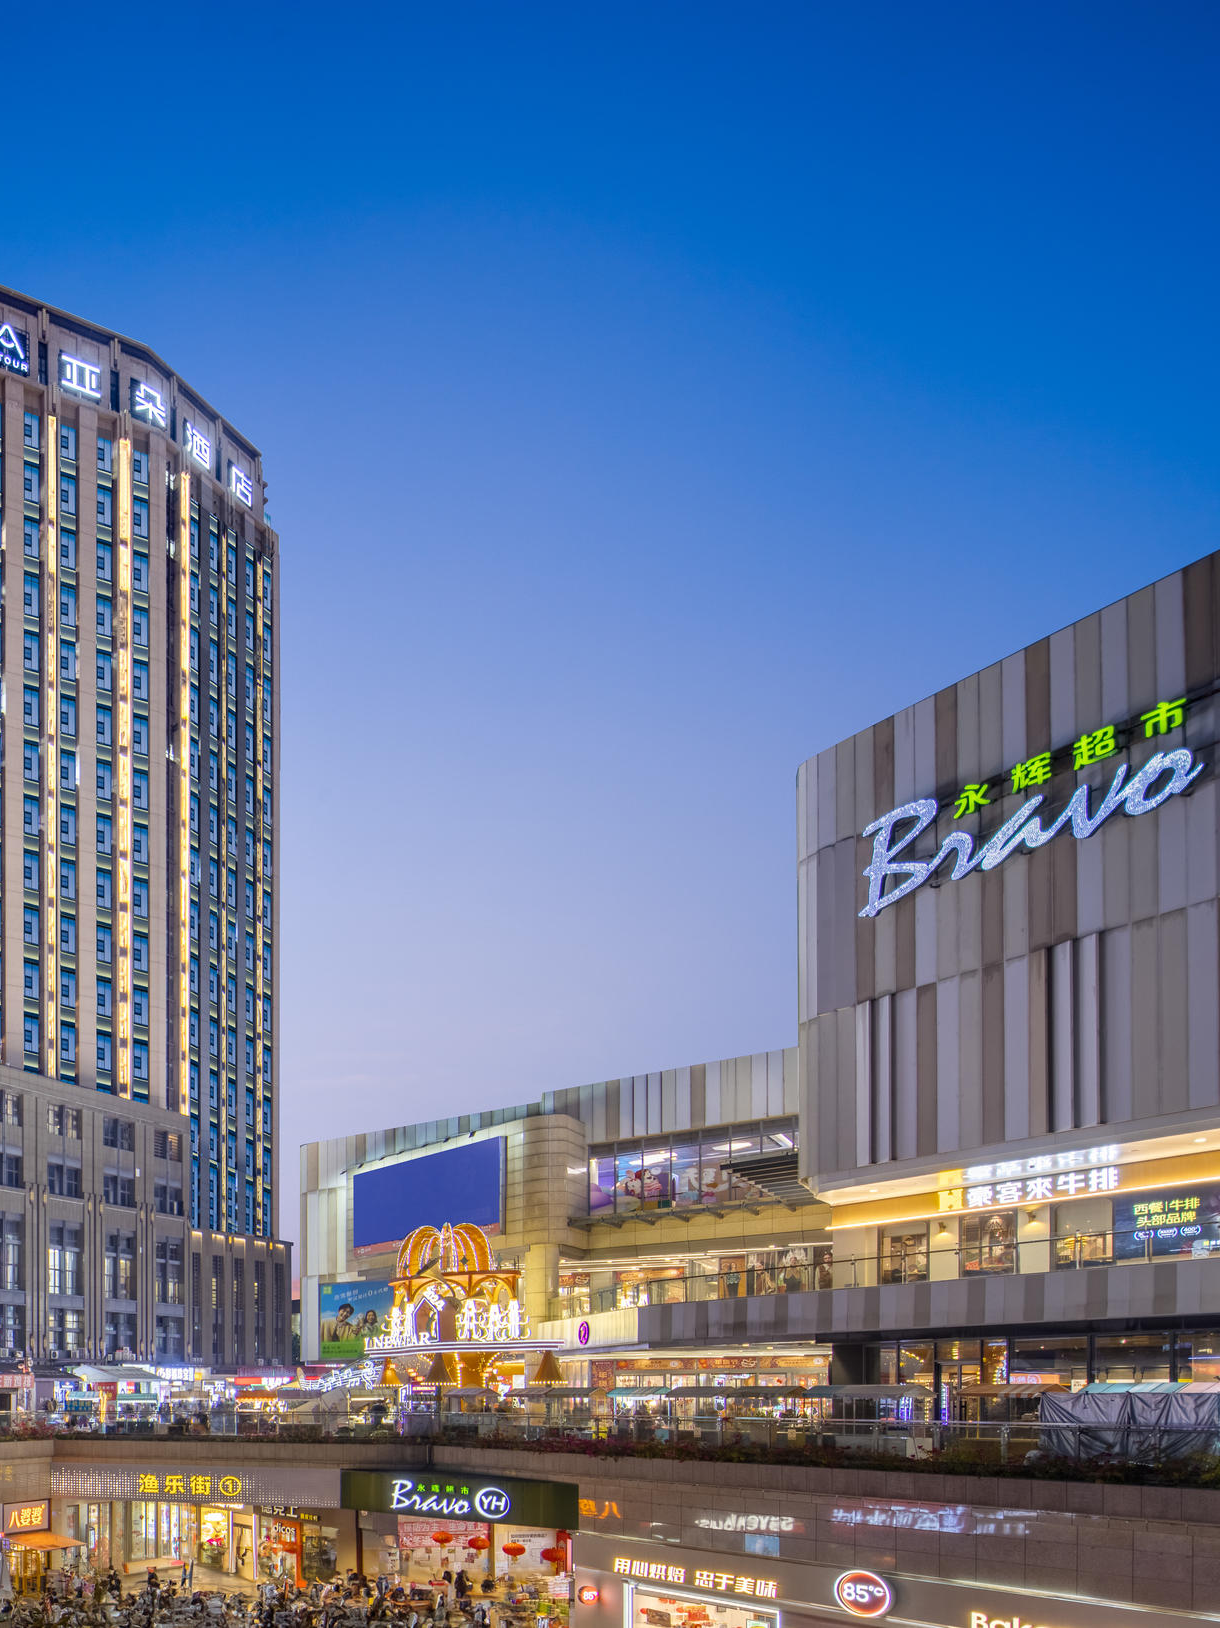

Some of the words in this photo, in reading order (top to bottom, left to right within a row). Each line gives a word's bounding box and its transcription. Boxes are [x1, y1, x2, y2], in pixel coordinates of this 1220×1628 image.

[61, 353, 253, 507] 亚朵酒店
[953, 698, 1187, 820] 永辉超市
[857, 748, 1204, 918] Bravo
[1136, 1211, 1196, 1228] 头部品牌
[139, 1474, 211, 1495] 渔乐街
[389, 1479, 472, 1515] Bravo
[481, 1495, 506, 1511] YH
[9, 1505, 45, 1529] 八婆婆
[274, 1522, 296, 1534] dicos
[614, 1557, 685, 1583] 用心烘焙
[695, 1571, 778, 1598] 忠于美味
[843, 1582, 884, 1602] 85°C
